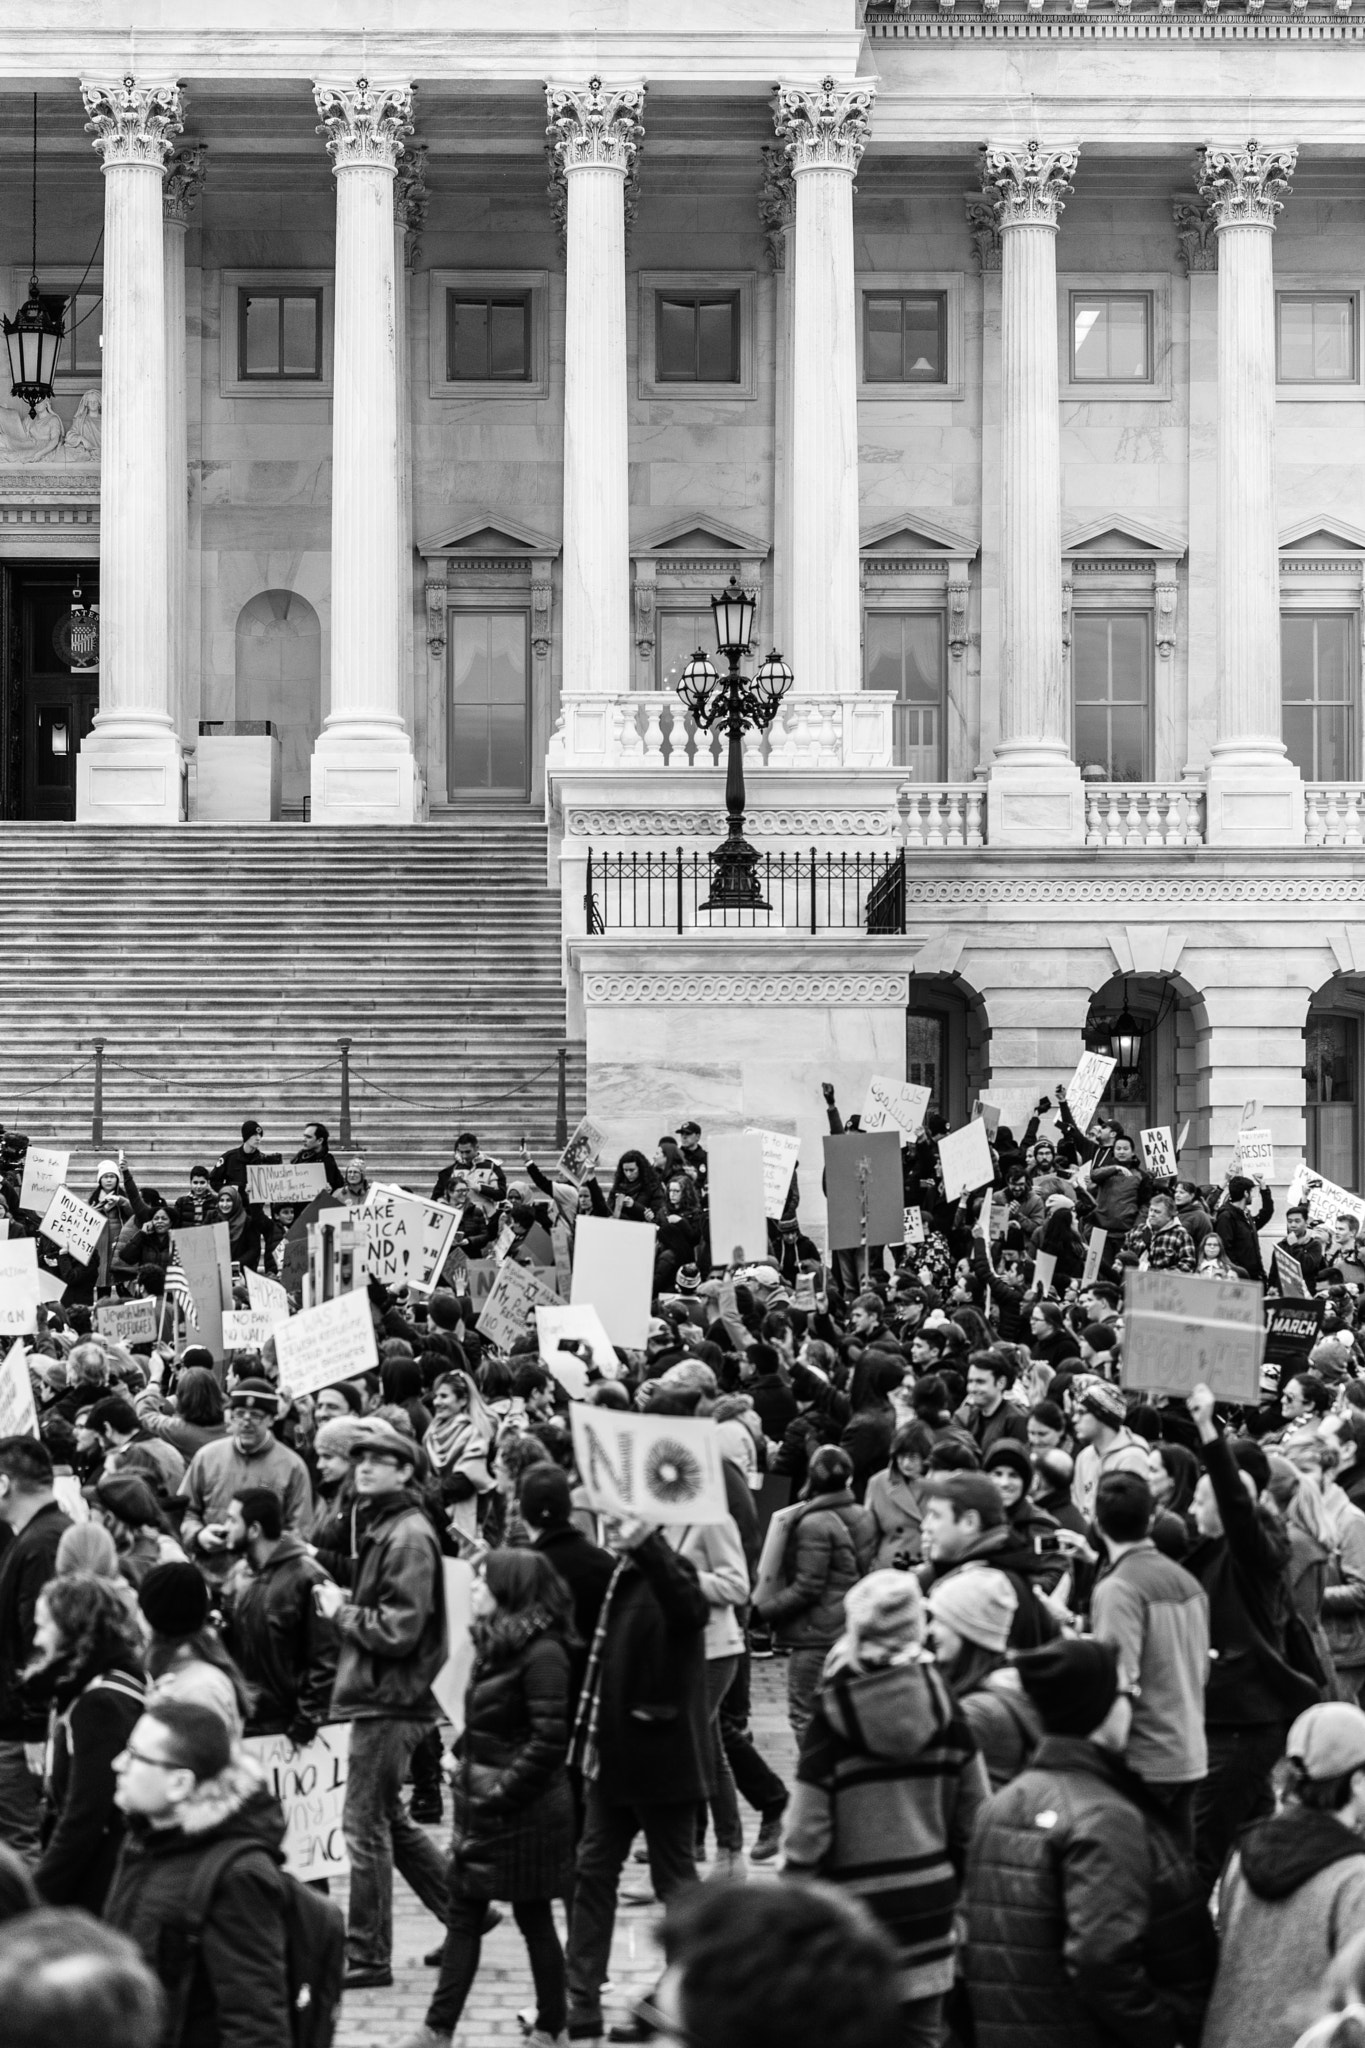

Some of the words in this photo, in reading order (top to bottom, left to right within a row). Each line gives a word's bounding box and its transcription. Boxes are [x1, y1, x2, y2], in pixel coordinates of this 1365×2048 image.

[1147, 1131, 1163, 1143] NO
[1145, 1140, 1169, 1156] BAN
[1241, 1143, 1272, 1159] RESIST
[1152, 1154, 1166, 1166] NO
[1147, 1164, 1174, 1178] ALL
[60, 1194, 101, 1229] MUSLIM
[349, 1204, 395, 1221] MAKE
[60, 1211, 81, 1229] BAN
[232, 1313, 249, 1326] NO
[1273, 1317, 1318, 1336] MARCH
